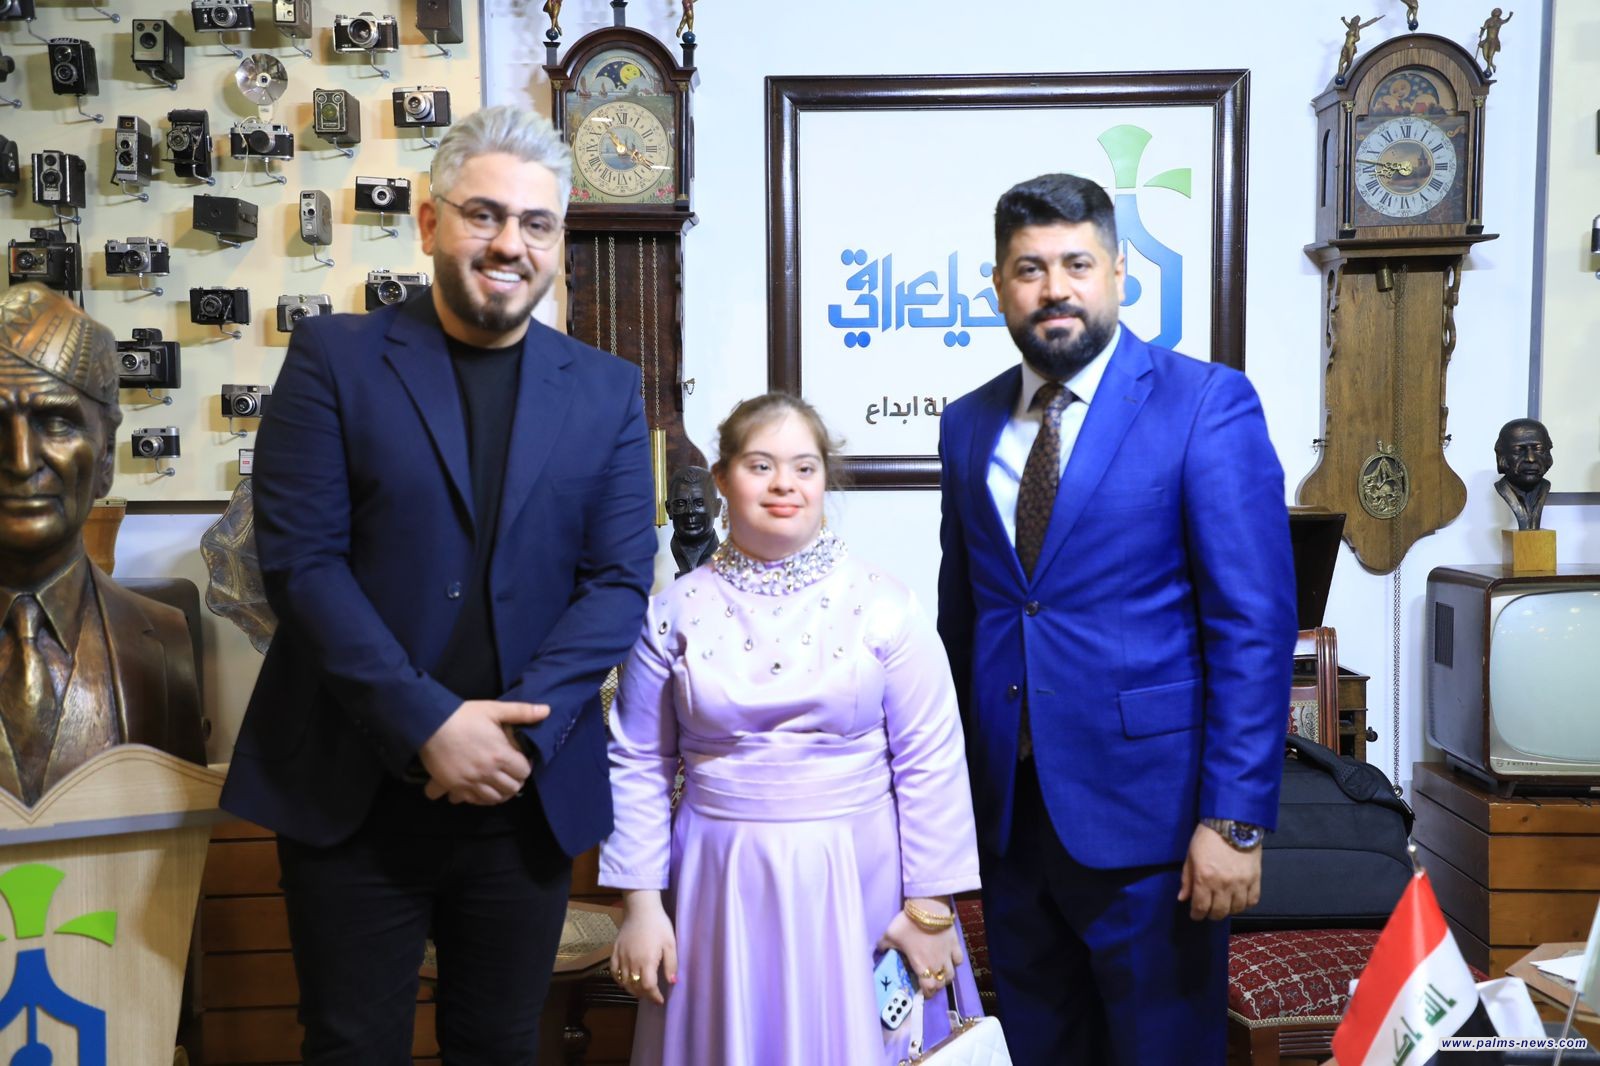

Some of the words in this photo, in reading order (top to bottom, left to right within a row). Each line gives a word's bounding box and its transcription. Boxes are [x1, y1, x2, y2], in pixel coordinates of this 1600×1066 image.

[1399, 125, 1412, 139] XII
[1430, 142, 1444, 154] II
[1434, 162, 1448, 171] III
[828, 249, 944, 348] عراقي
[908, 250, 1008, 347] خيل
[865, 395, 919, 425] ابداع
[923, 397, 947, 416] لة
